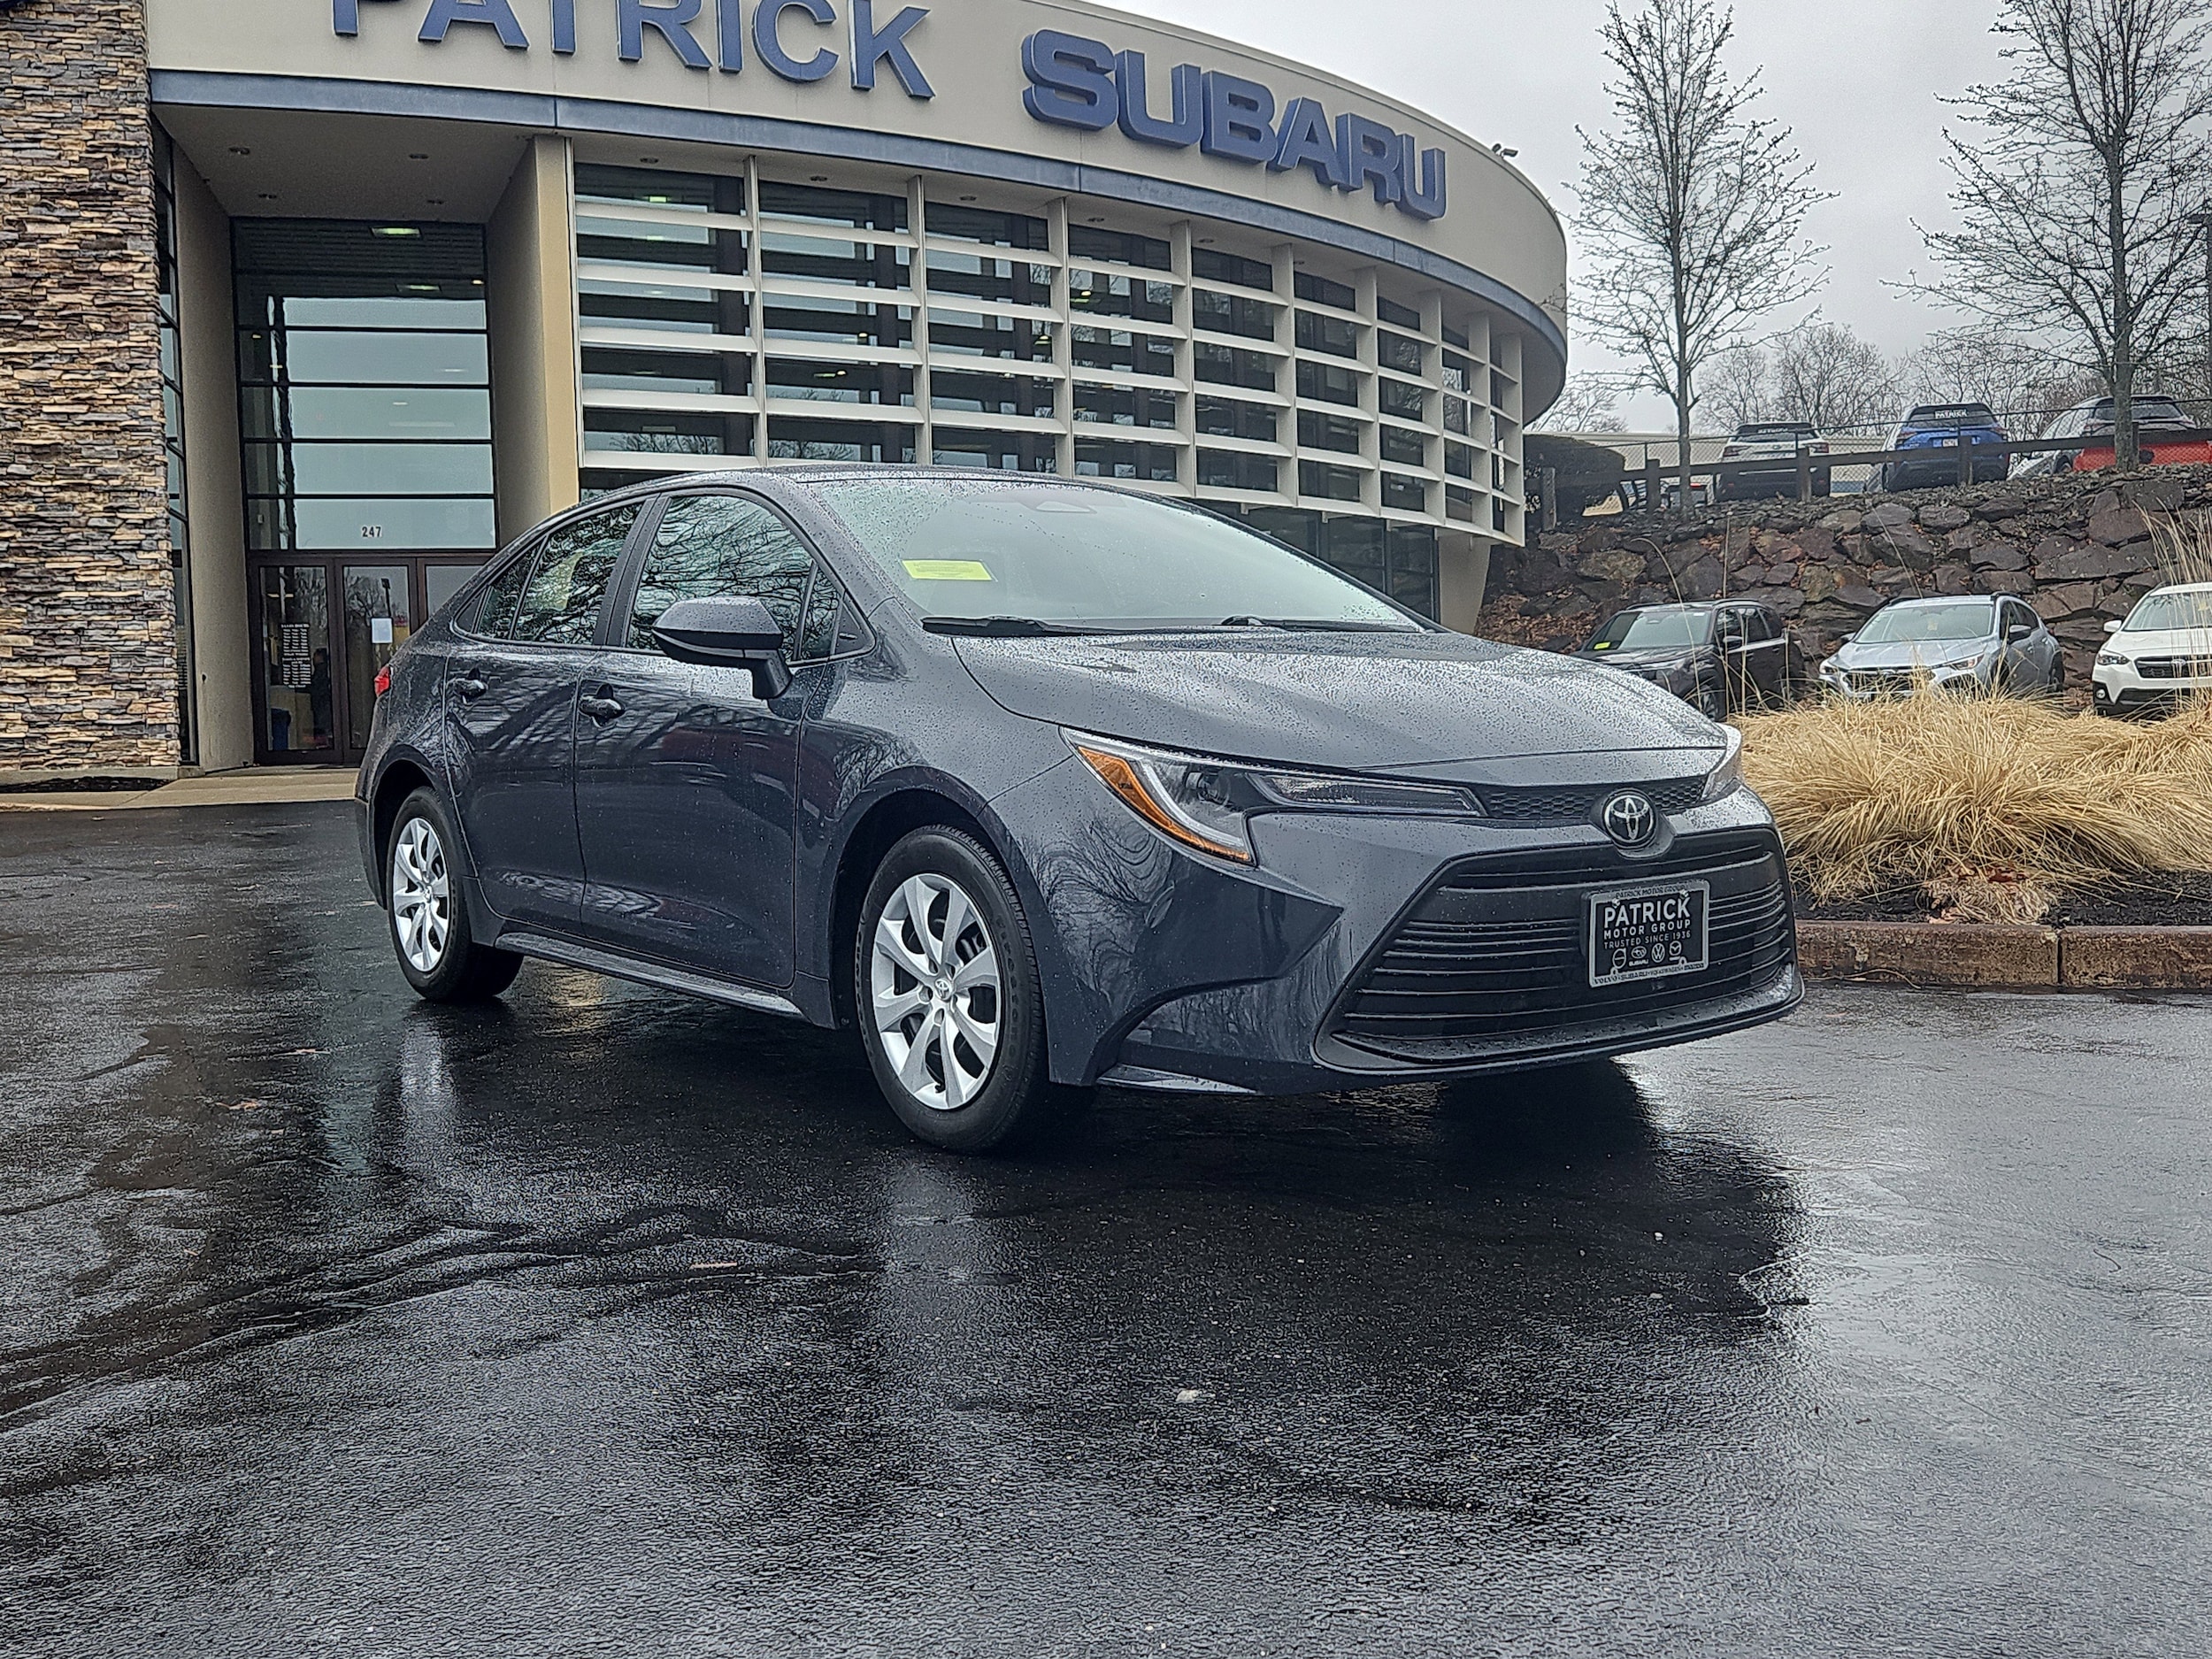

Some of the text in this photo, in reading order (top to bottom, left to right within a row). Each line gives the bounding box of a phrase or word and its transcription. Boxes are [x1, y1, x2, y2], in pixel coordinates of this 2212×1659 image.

[1021, 29, 1447, 220] SUBARU
[362, 526, 381, 538] 247
[1604, 896, 1691, 928] PATRICK
[1604, 919, 1691, 940] MOTOR GROUP
[1604, 930, 1691, 949] TRUSTED SINCE 1936
